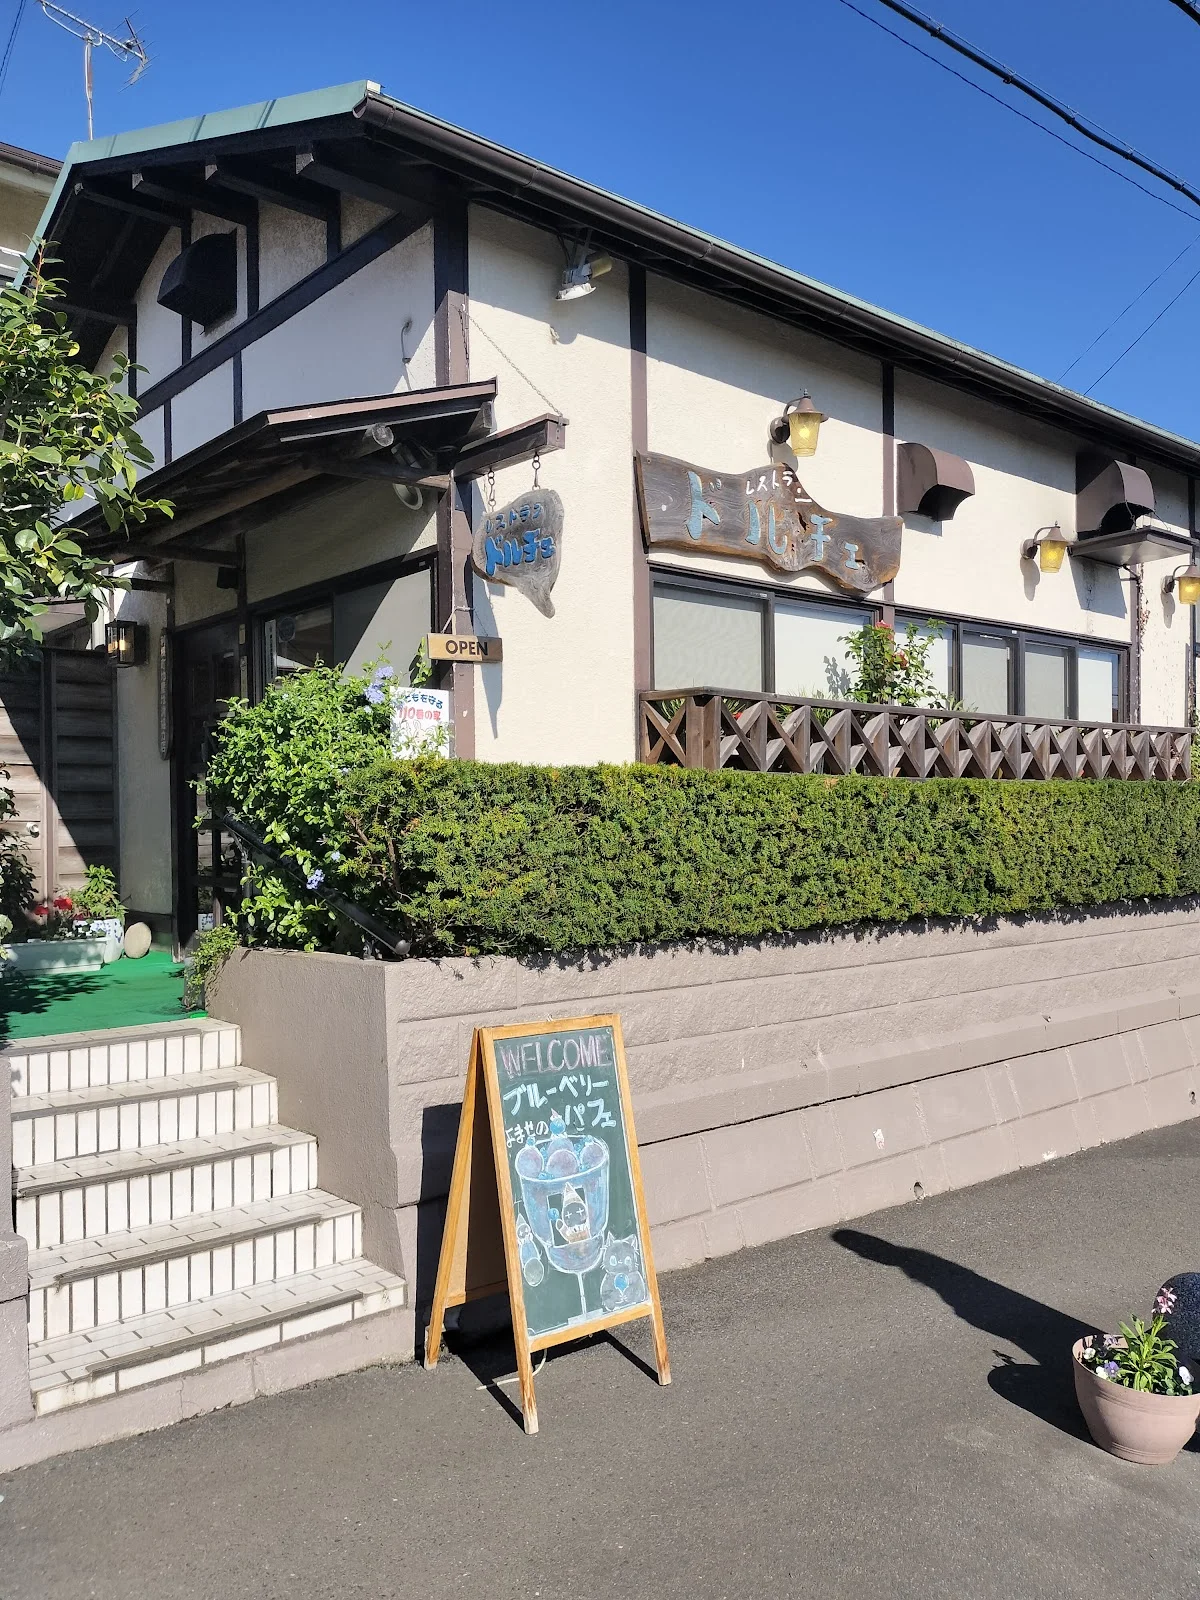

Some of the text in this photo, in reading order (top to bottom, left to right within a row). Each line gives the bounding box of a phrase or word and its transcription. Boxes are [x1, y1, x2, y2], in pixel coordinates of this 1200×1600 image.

[484, 502, 544, 534] レストラン
[685, 470, 860, 570] ドルチェ
[483, 528, 556, 577] ドルチェ
[445, 639, 489, 656] OPEN
[499, 1034, 613, 1080] WELCOME
[503, 1074, 610, 1116] ブルーベリー
[564, 1098, 617, 1129] パフェ
